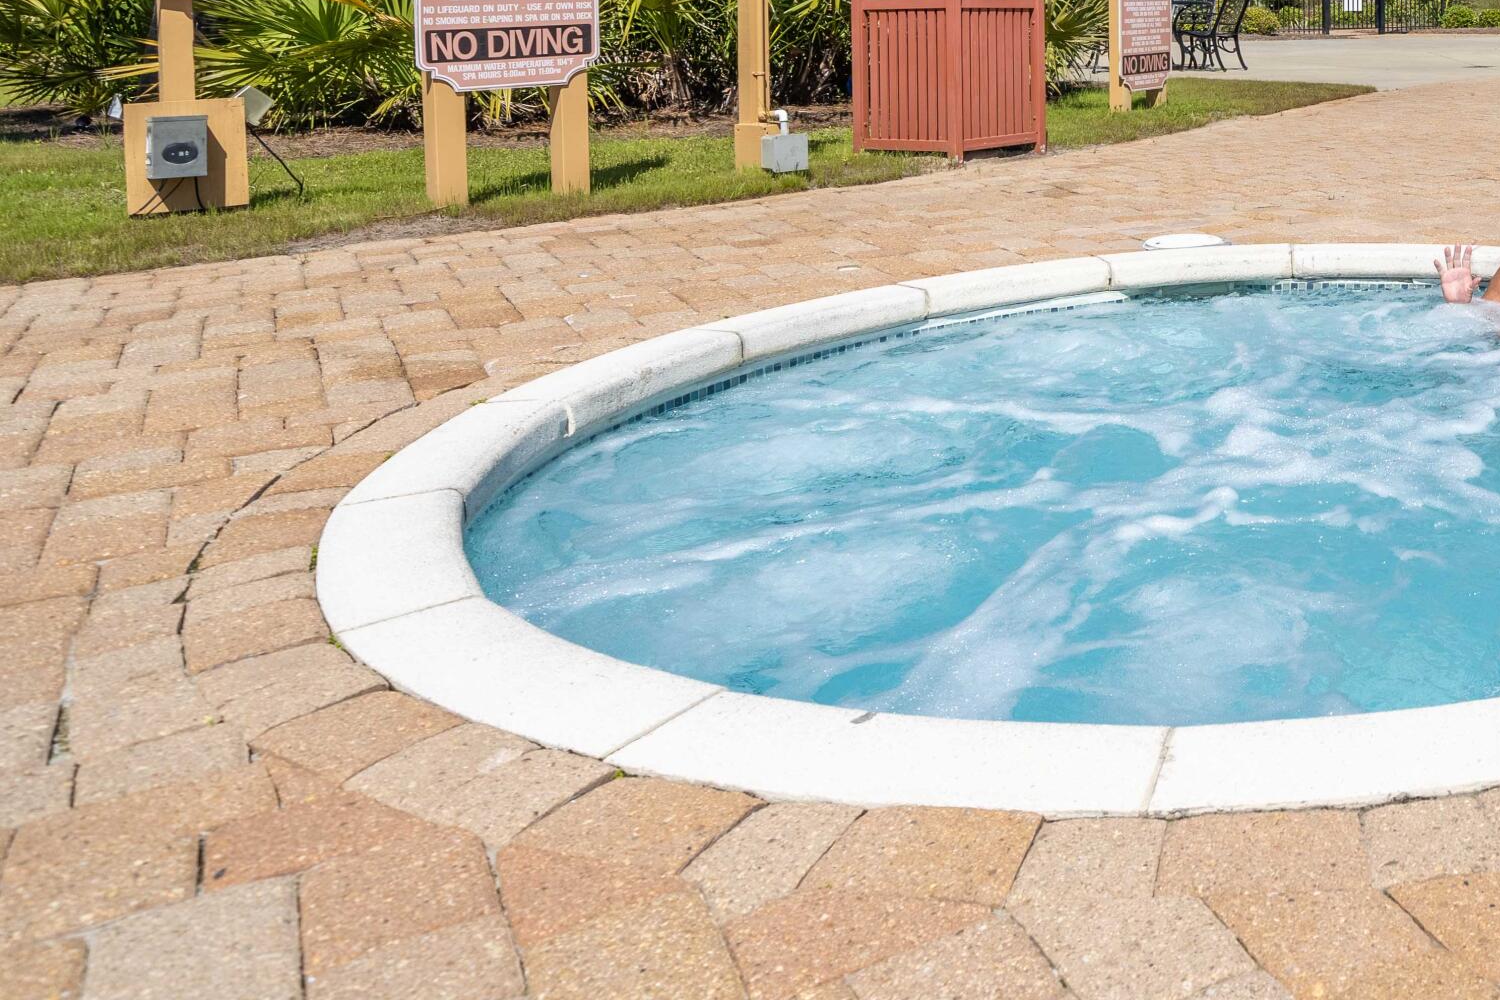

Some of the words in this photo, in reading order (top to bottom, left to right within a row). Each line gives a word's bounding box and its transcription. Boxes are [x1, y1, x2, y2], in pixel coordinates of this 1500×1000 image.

[423, 6, 435, 14] NO
[437, 5, 480, 14] LIFEGUARD
[483, 4, 494, 12] ON
[497, 3, 519, 12] DUTY
[527, 3, 542, 11] USE
[545, 2, 554, 10] AT
[576, 1, 592, 9] RISK
[423, 17, 433, 25] NO
[435, 16, 468, 25] SMOKING
[470, 16, 481, 24] OR
[515, 14, 523, 22] IN
[525, 13, 538, 22] SPA
[540, 13, 549, 21] OR
[551, 13, 560, 21] ON
[562, 12, 575, 20] SPA
[576, 12, 593, 20] DECK
[430, 31, 478, 61] NO
[487, 26, 583, 59] DIVING
[447, 64, 481, 73] MAXIMUM
[484, 62, 506, 71] WATER
[508, 59, 555, 69] TEMPERATURE
[1124, 56, 1137, 75] NO
[1140, 53, 1168, 73] DIVING
[463, 72, 476, 80] SPA
[478, 70, 501, 79] HOURS
[527, 68, 536, 76] TO
